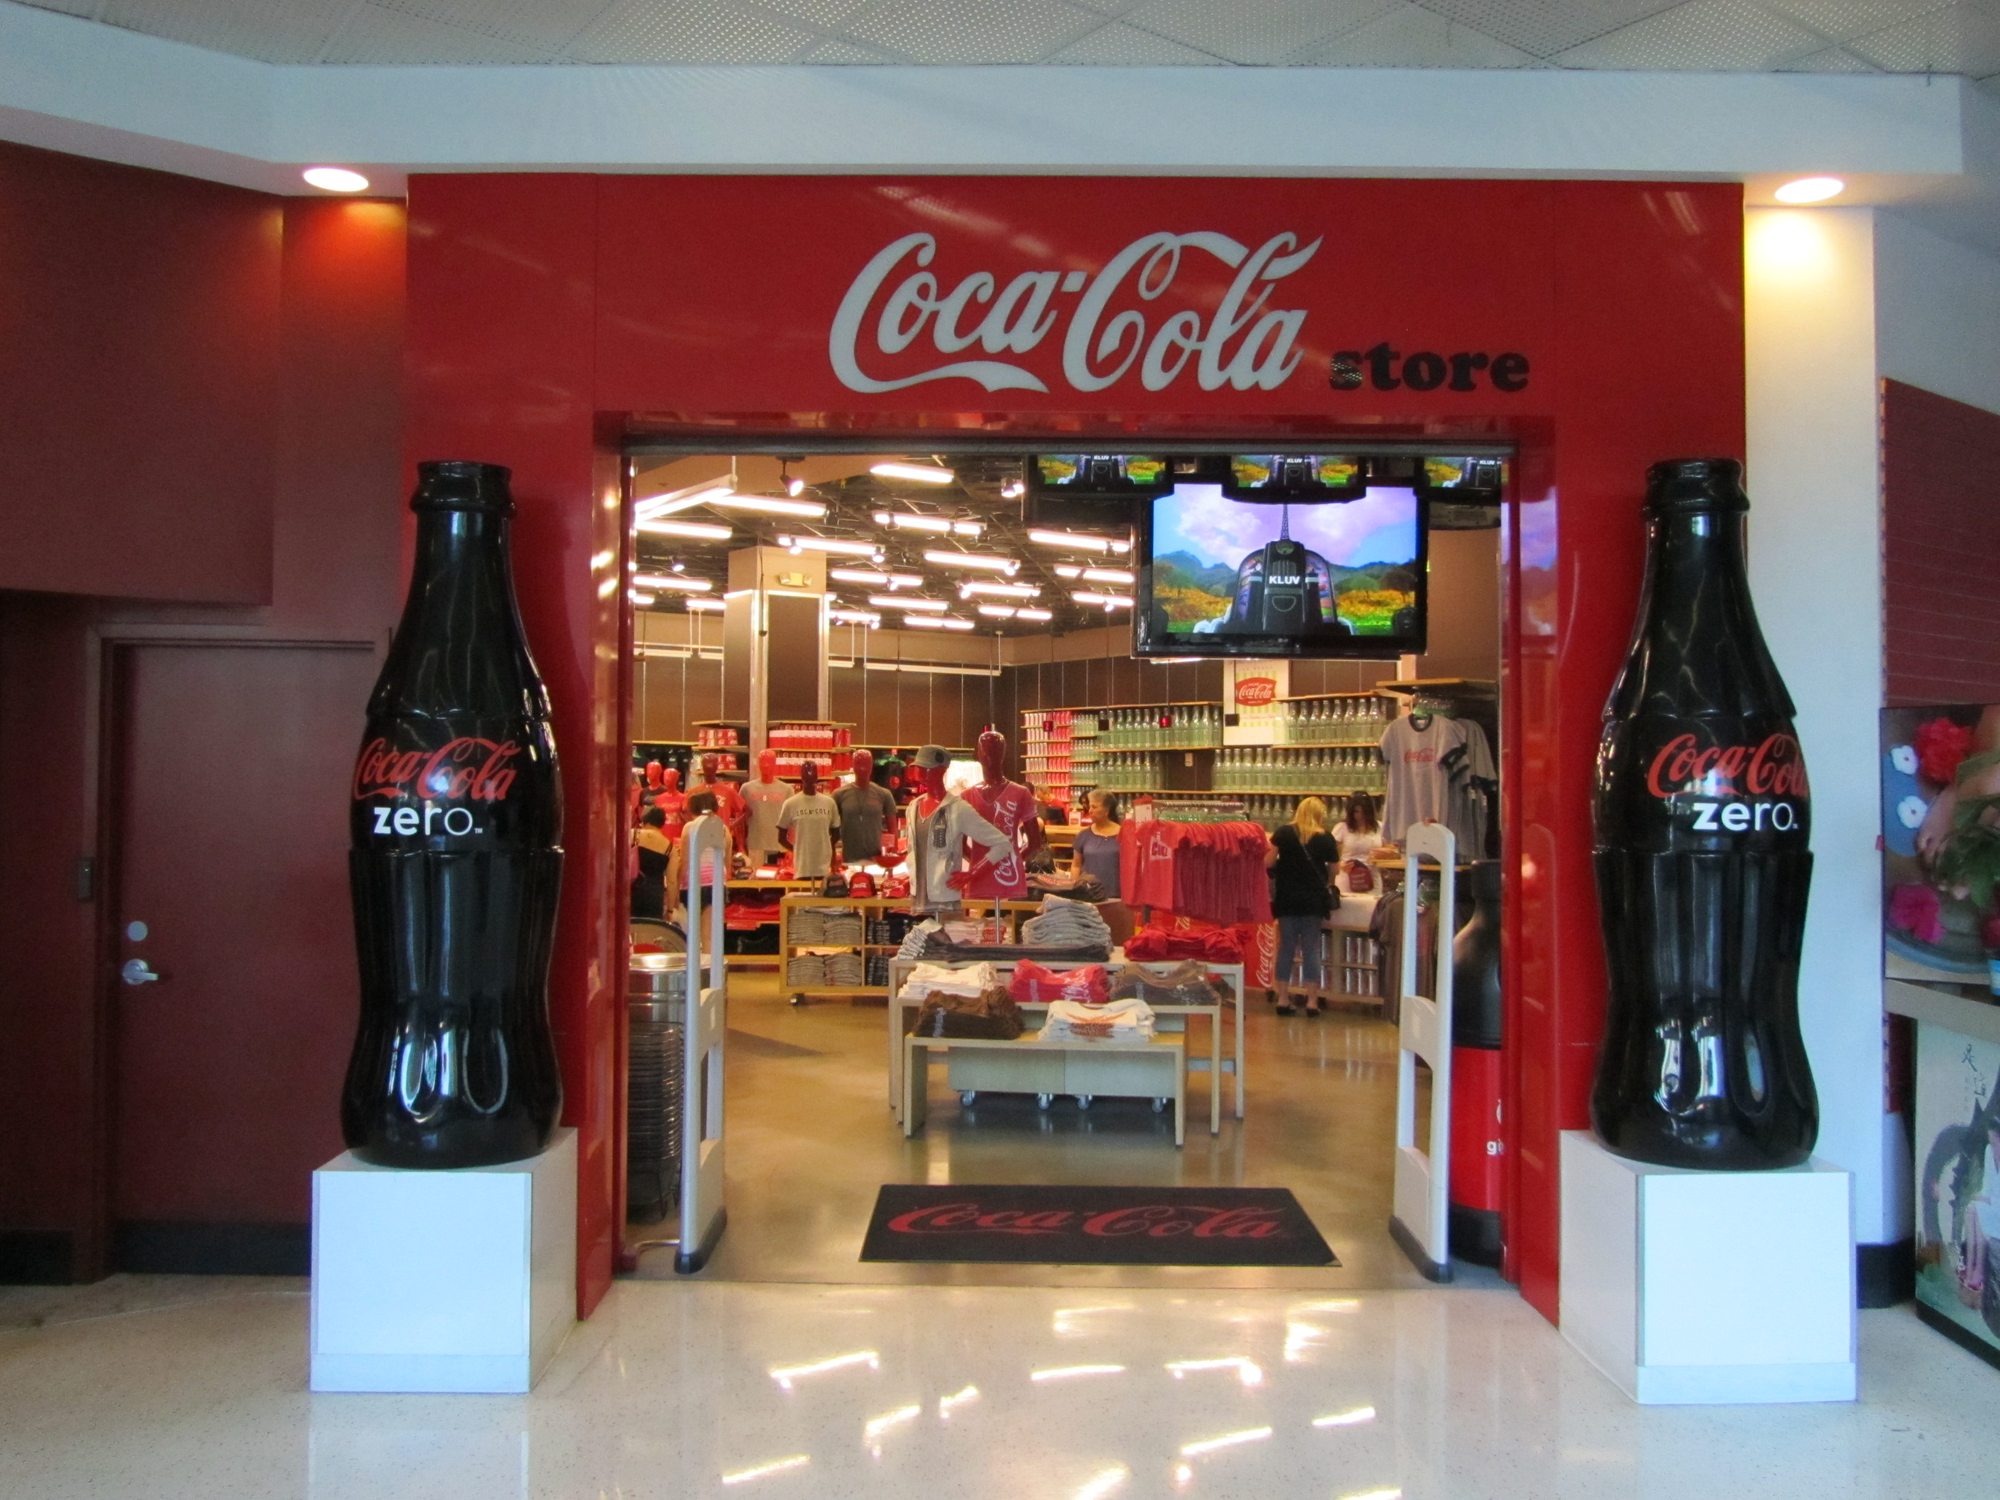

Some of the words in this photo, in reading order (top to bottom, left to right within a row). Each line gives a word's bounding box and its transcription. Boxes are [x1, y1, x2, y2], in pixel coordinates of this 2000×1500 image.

[829, 231, 1323, 393] Coca-Cola
[1329, 341, 1530, 391] store
[1268, 575, 1301, 585] KLUV
[353, 737, 521, 800] Coca-Cola
[373, 806, 473, 836] zero
[1692, 802, 1794, 831] zero
[888, 1203, 1288, 1238] Coca-Cola
